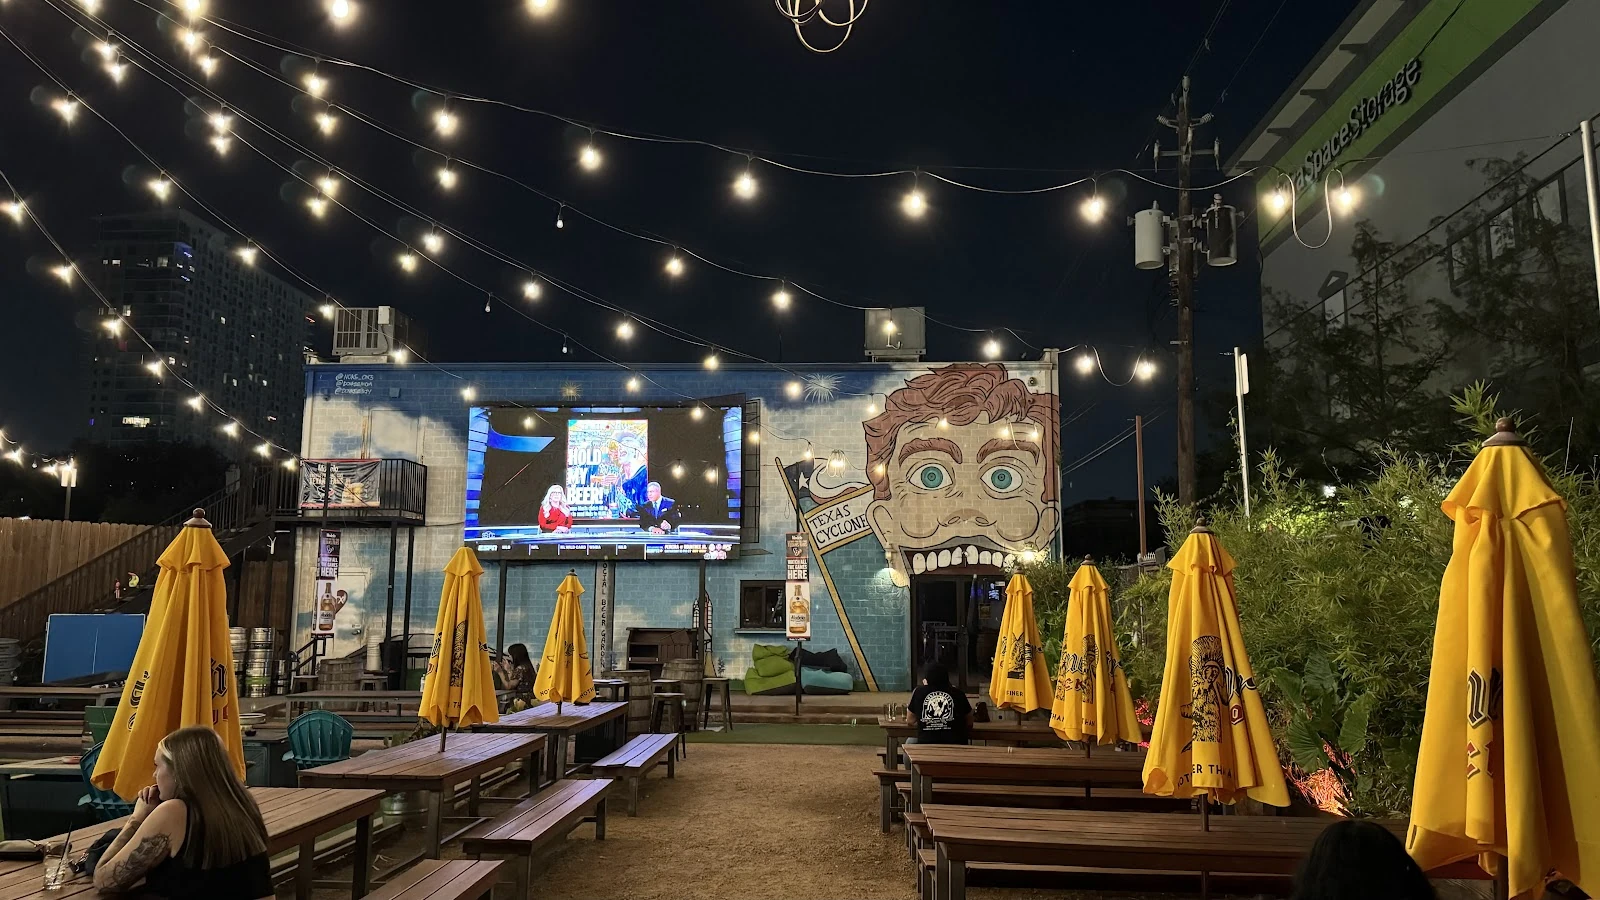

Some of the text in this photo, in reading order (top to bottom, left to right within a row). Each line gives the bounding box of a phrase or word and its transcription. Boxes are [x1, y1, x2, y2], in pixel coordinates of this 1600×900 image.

[568, 447, 602, 466] HOLD
[567, 467, 589, 485] MY
[567, 486, 604, 505] BEER!
[809, 504, 851, 529] TEXAS
[815, 513, 869, 544] CYCLONE
[320, 567, 338, 577] HERE
[787, 570, 808, 580] HERE
